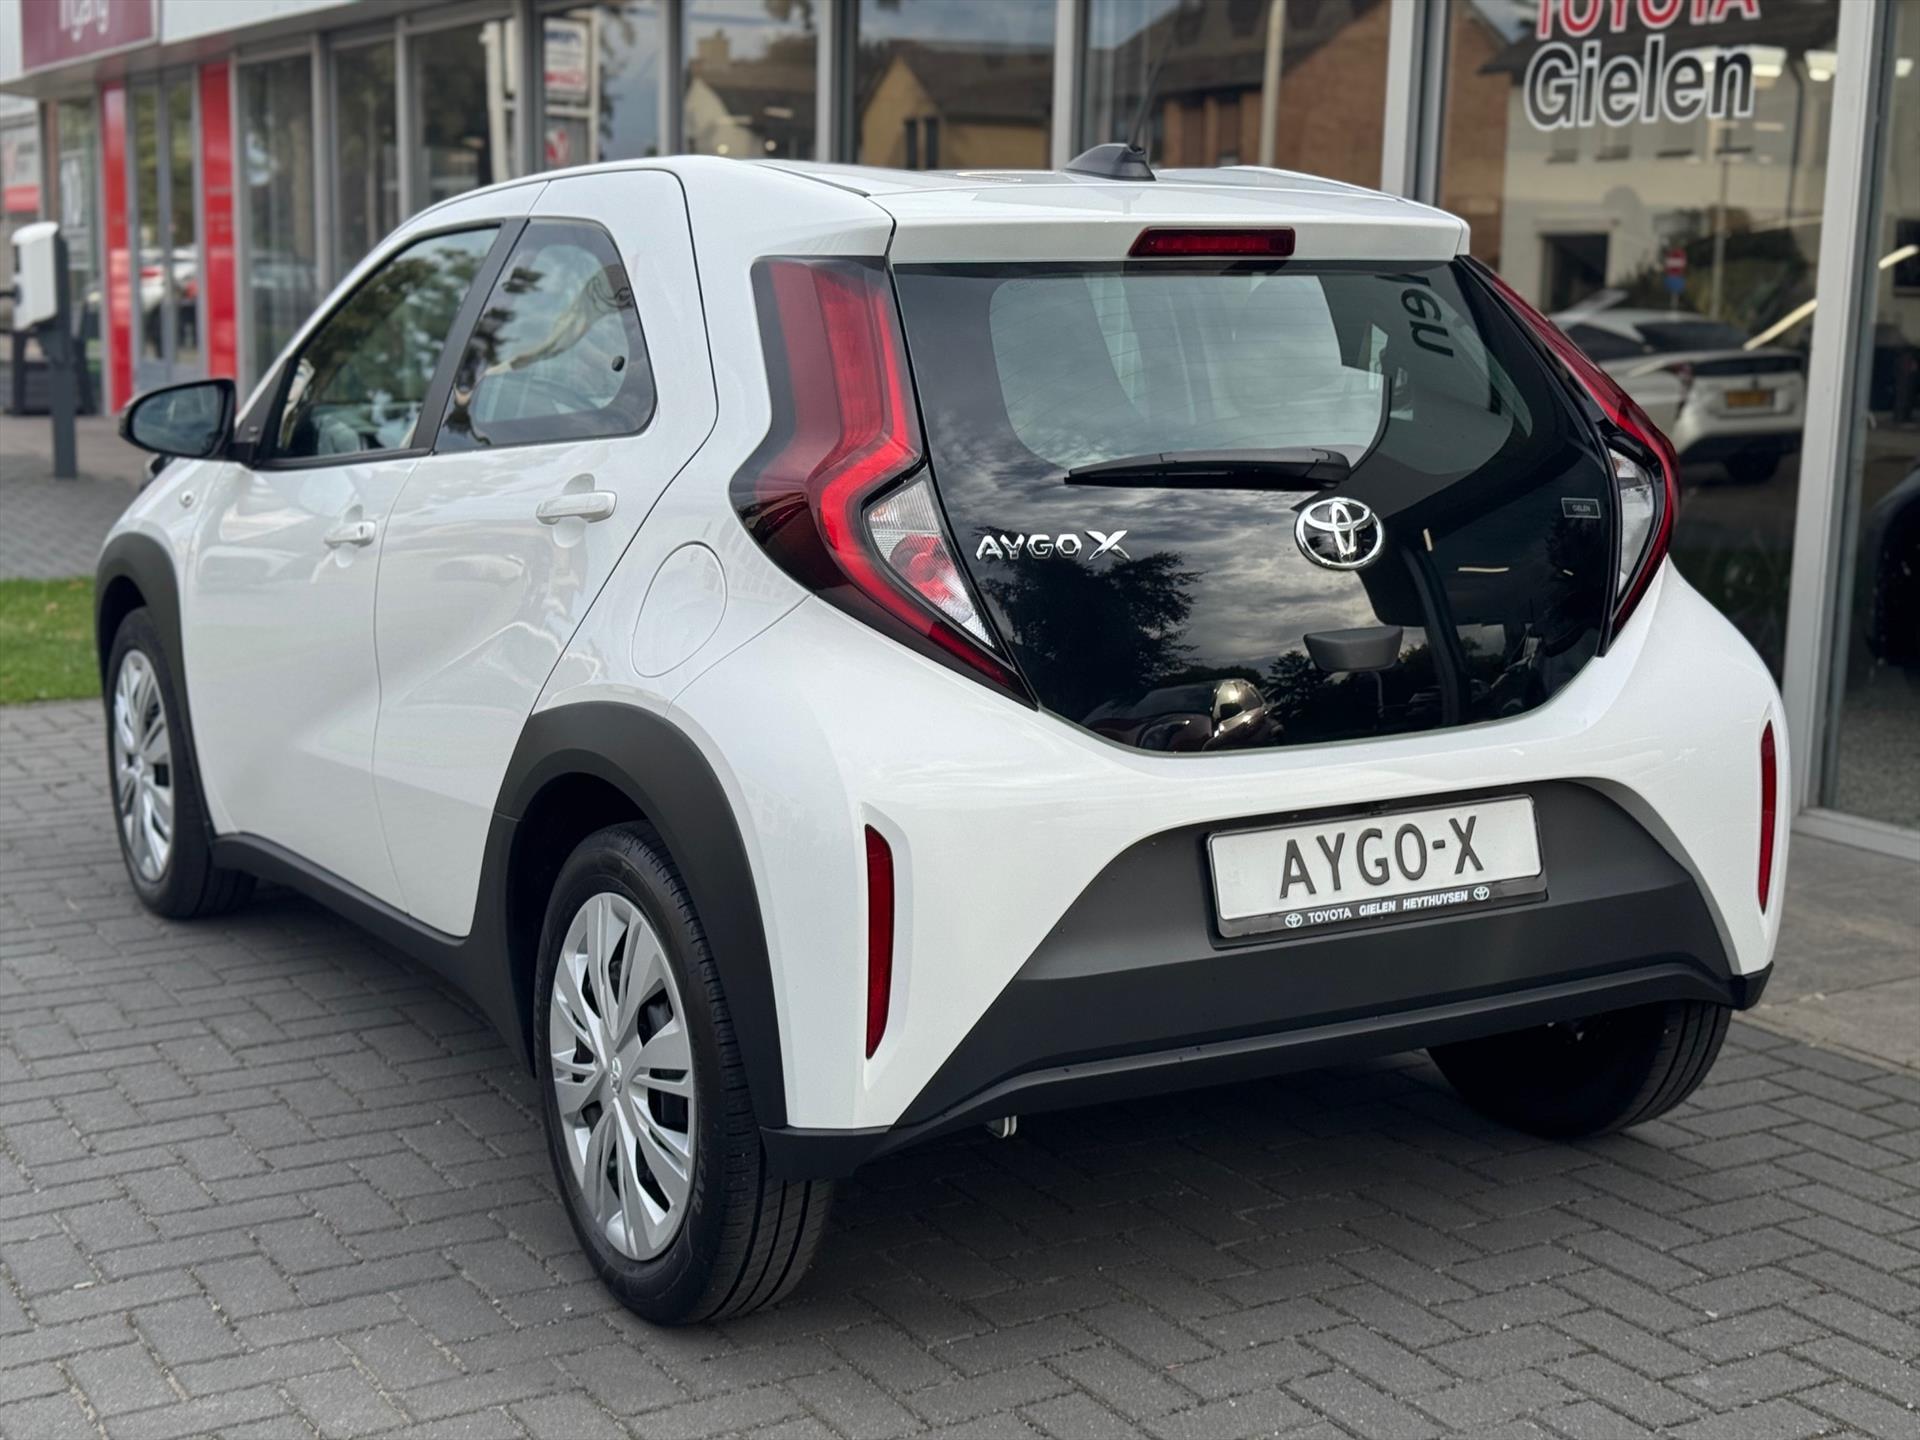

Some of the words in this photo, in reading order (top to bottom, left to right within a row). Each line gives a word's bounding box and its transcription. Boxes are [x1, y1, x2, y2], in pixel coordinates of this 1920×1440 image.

[1524, 34, 1754, 131] Gielen
[975, 533, 1082, 560] AYGO
[1085, 530, 1131, 560] X
[1280, 815, 1484, 899] AYGO-X
[1307, 907, 1352, 924] TOYOTA
[1359, 901, 1396, 916] GIELEN
[1403, 890, 1468, 911] HEYTHUYSEN
